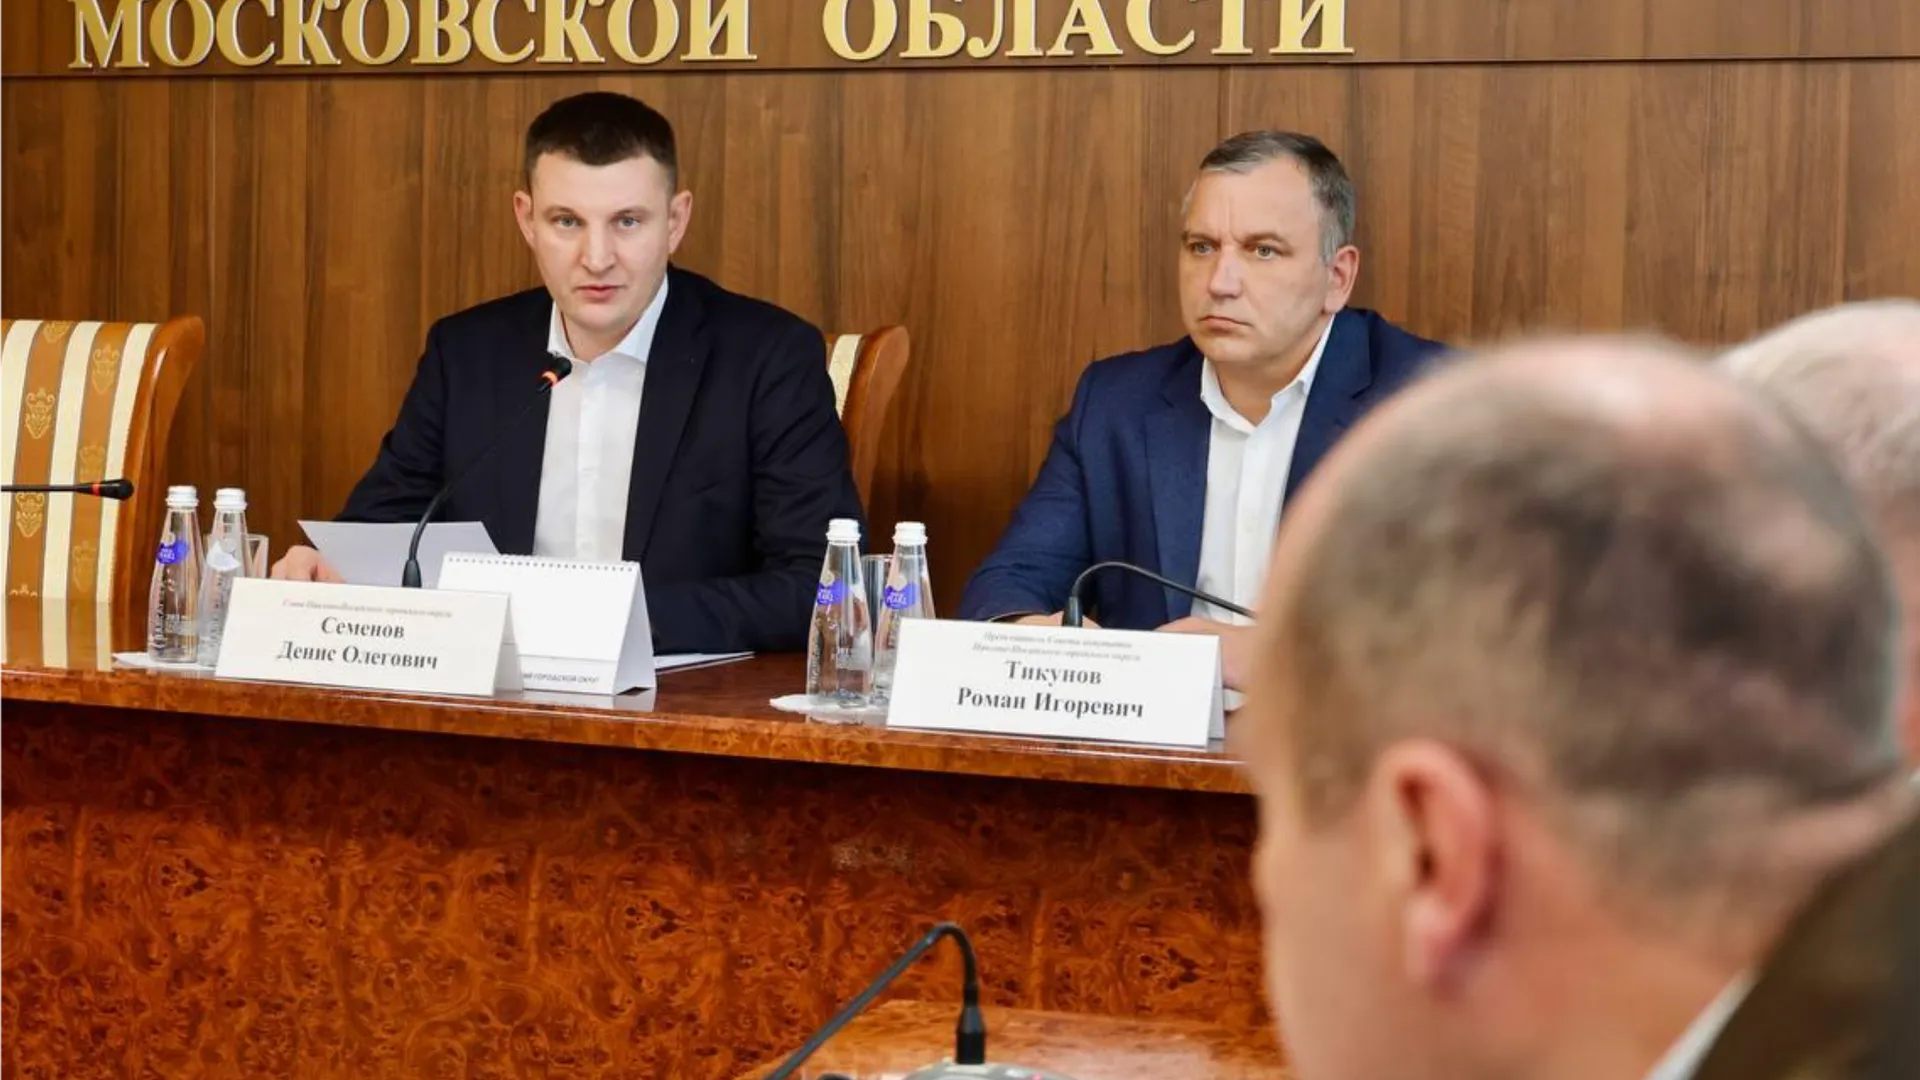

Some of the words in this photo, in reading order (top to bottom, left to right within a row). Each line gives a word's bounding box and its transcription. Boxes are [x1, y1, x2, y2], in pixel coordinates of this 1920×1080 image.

[822, 0, 1355, 60] ОБЛАСТИ
[320, 616, 405, 639] Семенов
[276, 641, 336, 662] Денис
[341, 645, 438, 669] Олегович
[1004, 659, 1102, 687] Тикунов
[957, 686, 1026, 710] Роман
[1034, 692, 1144, 719] Игоревич
